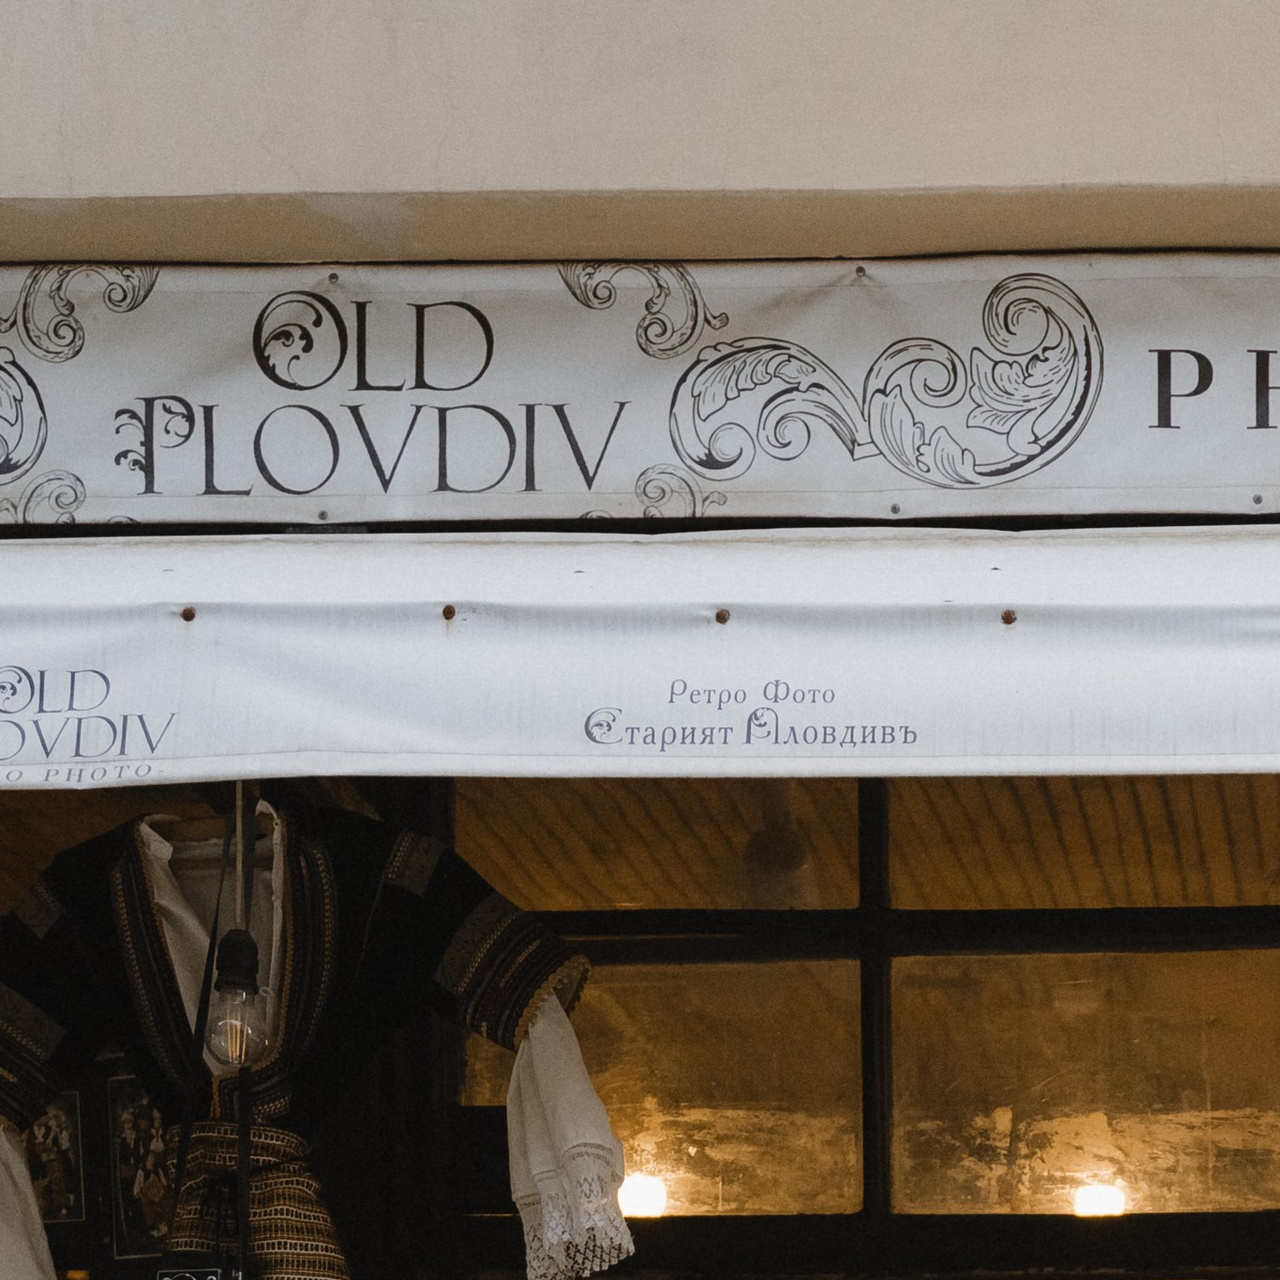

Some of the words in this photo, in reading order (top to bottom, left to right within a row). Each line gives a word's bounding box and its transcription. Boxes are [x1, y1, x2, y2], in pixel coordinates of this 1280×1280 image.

[252, 289, 495, 393] OLD
[114, 394, 627, 497] PLOVDIV
[584, 706, 734, 752] Старият
[742, 706, 918, 750] Пловдивъ
[667, 678, 748, 711] Ретро
[762, 679, 836, 704] Фото
